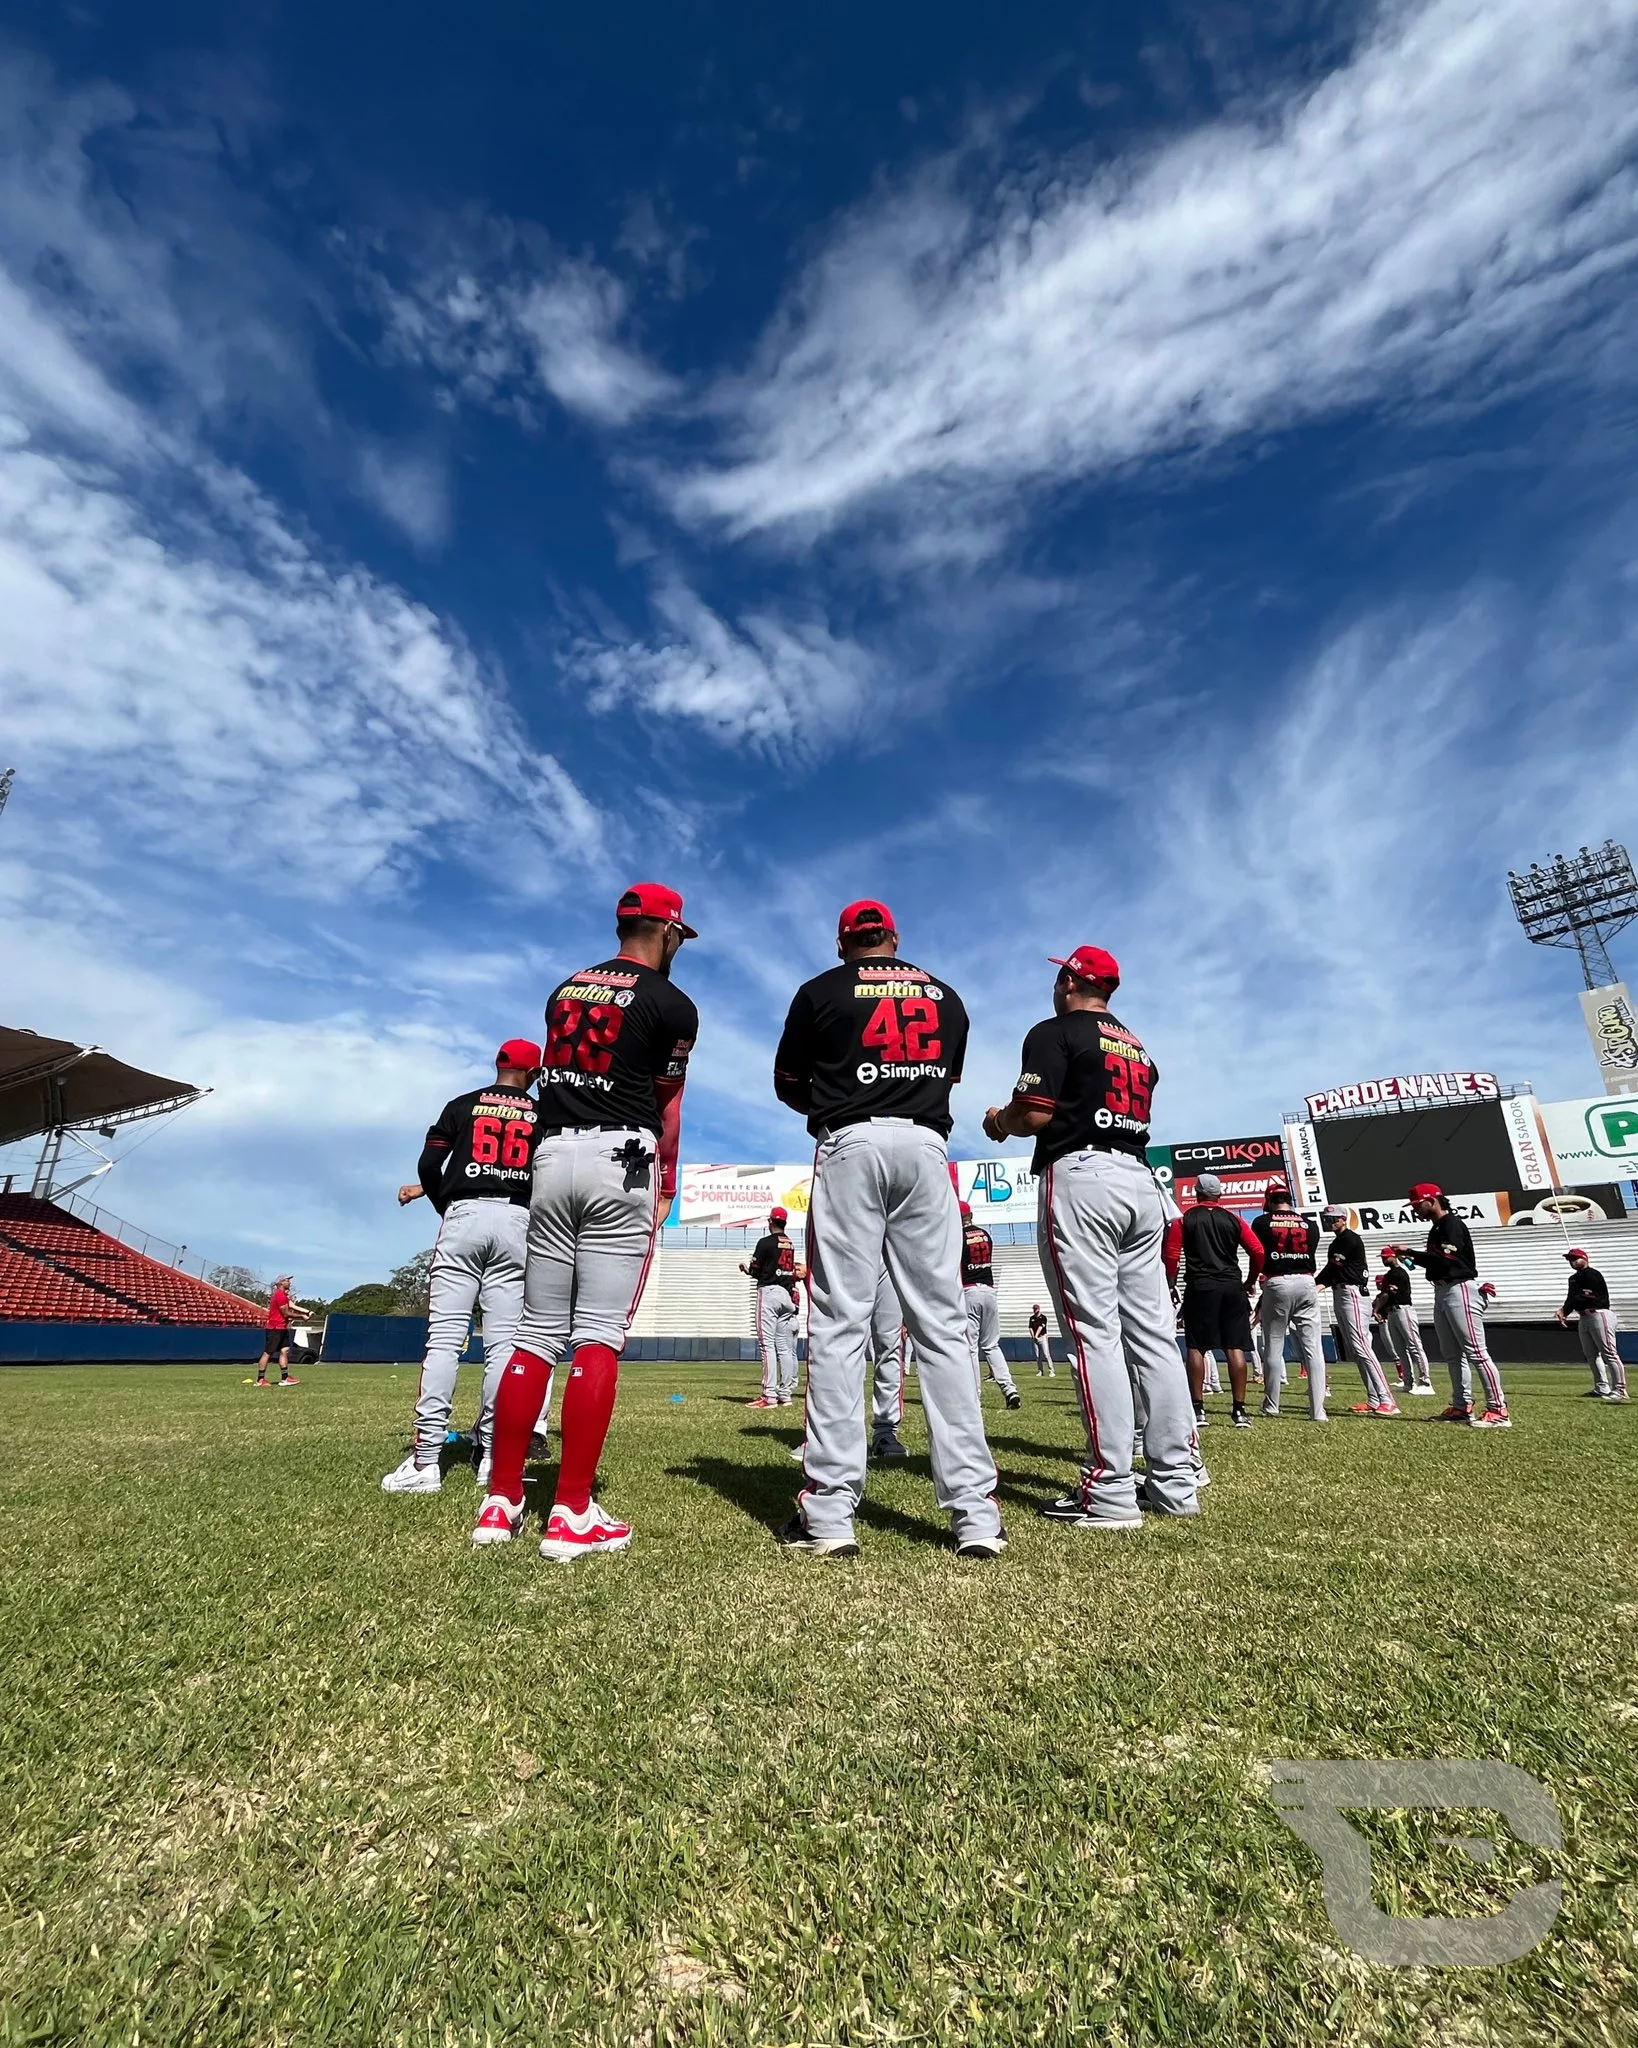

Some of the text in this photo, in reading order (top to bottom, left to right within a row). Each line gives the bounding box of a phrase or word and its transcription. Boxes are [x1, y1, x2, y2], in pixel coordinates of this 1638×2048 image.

[557, 984, 615, 1004] maltín
[855, 981, 922, 998] maltín
[543, 999, 624, 1074] 22
[862, 997, 941, 1061] 42
[550, 1068, 615, 1092] Simpletv
[880, 1063, 947, 1081] Simpletv
[1105, 1052, 1150, 1123] 35
[1304, 1072, 1500, 1118] CARDENALES
[472, 1116, 533, 1168] 66
[1299, 1126, 1312, 1161] ARAUCA
[1510, 1101, 1543, 1185] GRAN SABOR
[482, 1164, 531, 1180] Simpletv
[701, 1192, 775, 1203] PORTUGUESA
[1382, 1213, 1395, 1222] DE
[1271, 1227, 1309, 1252] 72
